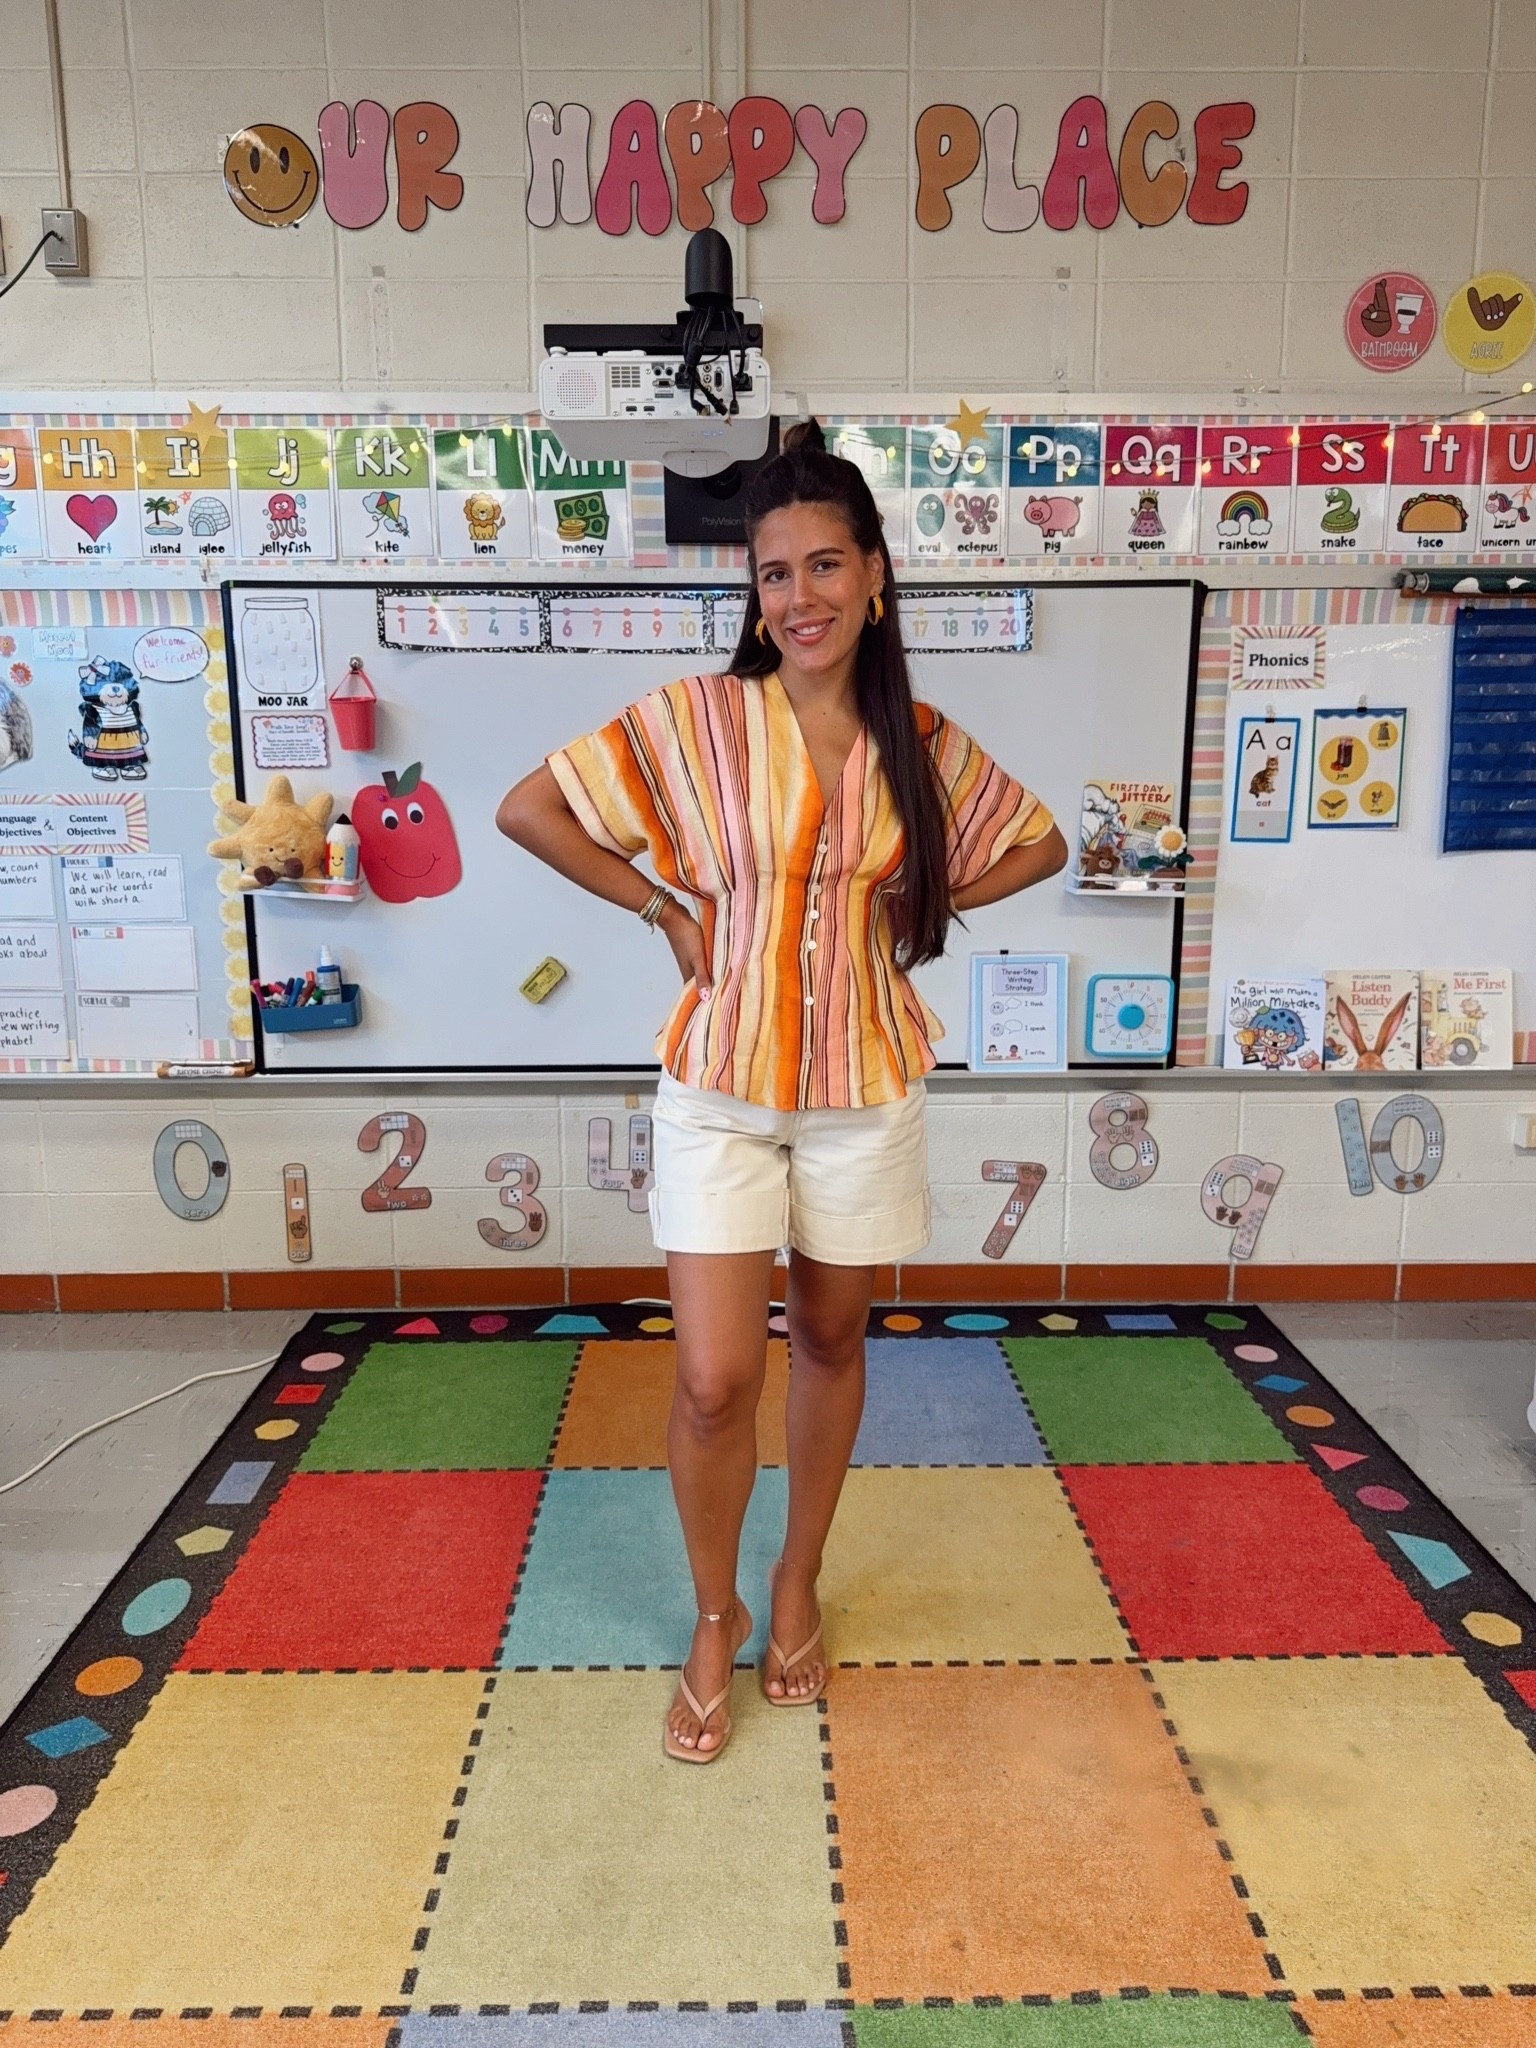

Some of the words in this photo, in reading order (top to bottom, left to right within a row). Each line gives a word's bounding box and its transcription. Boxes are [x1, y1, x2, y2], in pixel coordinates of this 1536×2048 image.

[526, 96, 868, 236] HAPPY
[914, 95, 1255, 233] PLACE
[1361, 341, 1418, 358] BATHROOM
[1470, 341, 1504, 359] AGREE
[59, 437, 117, 478] Hh
[165, 436, 200, 477] Ii
[354, 436, 412, 477] Kk
[465, 437, 497, 478] Ll
[928, 435, 987, 476] Oo
[1029, 434, 1082, 483] Pp
[1122, 434, 1181, 483] Qq
[1222, 435, 1272, 475] Rr
[1321, 433, 1365, 472] Ss
[1419, 434, 1460, 472] Tt
[1508, 432, 1536, 472] U
[268, 437, 299, 486] Jj
[78, 542, 112, 554] heart
[150, 542, 181, 553] island
[199, 543, 225, 556] igloo
[259, 542, 311, 556] jellyfish
[375, 541, 400, 553] kite
[474, 543, 496, 555] lion
[918, 542, 941, 553] oval
[957, 542, 998, 554] octopus
[1044, 540, 1061, 553] pig
[1128, 540, 1165, 552] queen
[1218, 539, 1268, 551] rainbow
[1321, 537, 1356, 548] snake
[1418, 537, 1443, 548] taco
[1482, 539, 1520, 547] unicorn
[562, 543, 604, 556] money
[398, 617, 405, 634] 1
[428, 618, 438, 635] 2
[459, 619, 469, 636] 3
[488, 619, 499, 636] 4
[519, 619, 529, 636] 5
[562, 620, 572, 637] 6
[592, 620, 602, 637] 7
[622, 620, 633, 638] 8
[652, 620, 663, 638] 9
[678, 620, 697, 638] 10
[912, 620, 929, 637] 17
[942, 620, 958, 637] 18
[971, 619, 989, 637] 19
[1000, 618, 1020, 636] 20
[145, 635, 186, 648] Welcome
[1249, 653, 1309, 667] Phonics
[258, 696, 282, 707] MOO
[286, 696, 308, 706] JAR
[1246, 729, 1266, 750] A
[1276, 736, 1291, 750] a
[1110, 783, 1139, 793] FIRST
[1143, 784, 1164, 793] DAY
[1119, 792, 1172, 803] JITTERS
[69, 814, 108, 823] Content
[66, 827, 117, 838] Objectives
[11, 861, 39, 872] count
[71, 871, 88, 882] We
[93, 869, 112, 880] will
[148, 866, 167, 877] read
[69, 884, 87, 895] and
[91, 882, 118, 895] write
[123, 881, 153, 891] words
[75, 897, 97, 907] with
[102, 895, 129, 905] short
[17, 934, 36, 946] and
[20, 949, 48, 958] about
[1002, 968, 1039, 976] Three-Step
[1005, 984, 1034, 992] Strategy
[1352, 980, 1391, 992] Listen
[1453, 978, 1468, 989] Me
[1476, 978, 1507, 989] First
[1233, 986, 1246, 995] The
[1231, 996, 1265, 1008] Million
[1352, 994, 1392, 1007] Buddy
[21, 1020, 59, 1033] writing
[1089, 1091, 1159, 1190] 8
[1335, 1093, 1444, 1197] 10
[357, 1111, 432, 1212] 2
[587, 1114, 656, 1213] 4
[153, 1119, 231, 1222] 0
[989, 1172, 1019, 1181] seven
[600, 1179, 624, 1188] four
[1114, 1175, 1141, 1187] eight
[386, 1201, 407, 1209] two
[477, 1152, 547, 1251] 3
[1201, 1154, 1284, 1260] 9
[184, 1208, 210, 1218] zero
[982, 1160, 1047, 1259] 7
[290, 1251, 309, 1259] one
